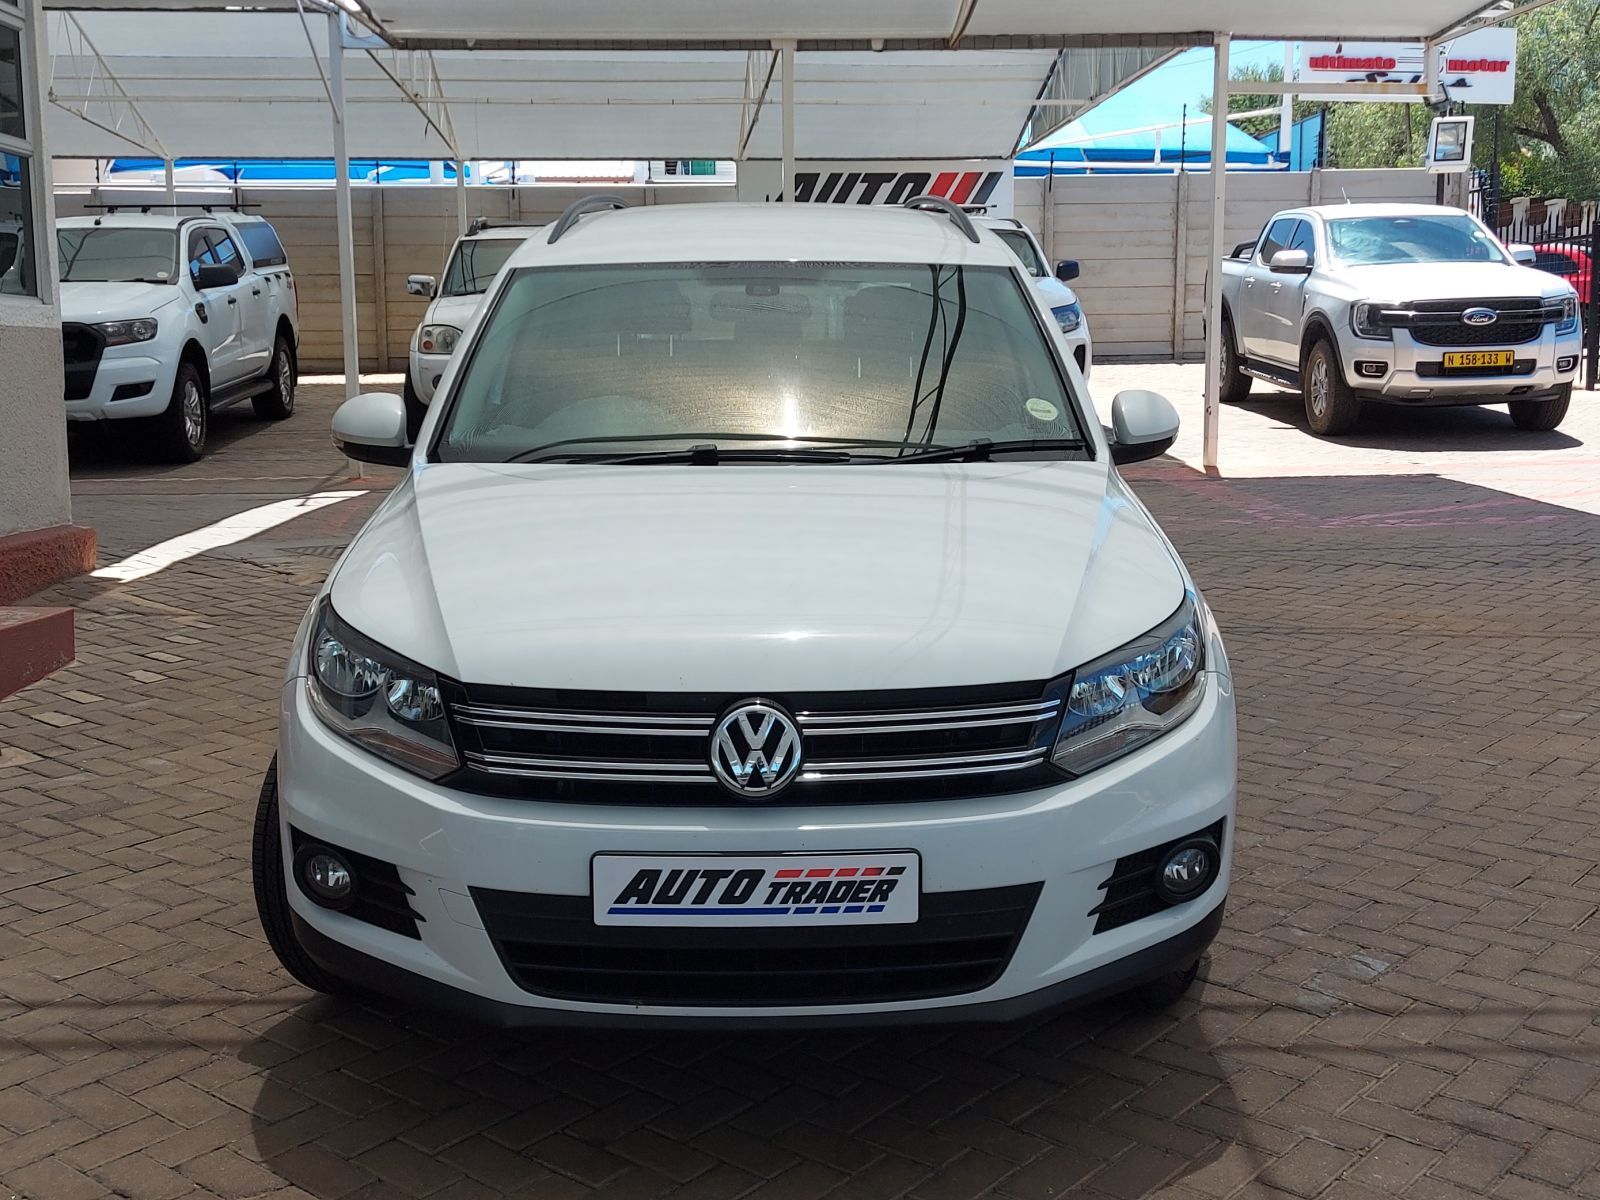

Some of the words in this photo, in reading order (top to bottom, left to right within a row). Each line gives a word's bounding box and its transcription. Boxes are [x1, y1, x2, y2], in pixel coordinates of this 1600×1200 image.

[1309, 55, 1397, 70] ultimate
[1447, 58, 1510, 73] motor
[775, 172, 932, 205] AUTO
[1448, 354, 1455, 366] N
[1459, 353, 1499, 366] 158-133
[1505, 352, 1512, 364] W
[613, 869, 766, 905] AUTO
[763, 879, 899, 905] TRADER
